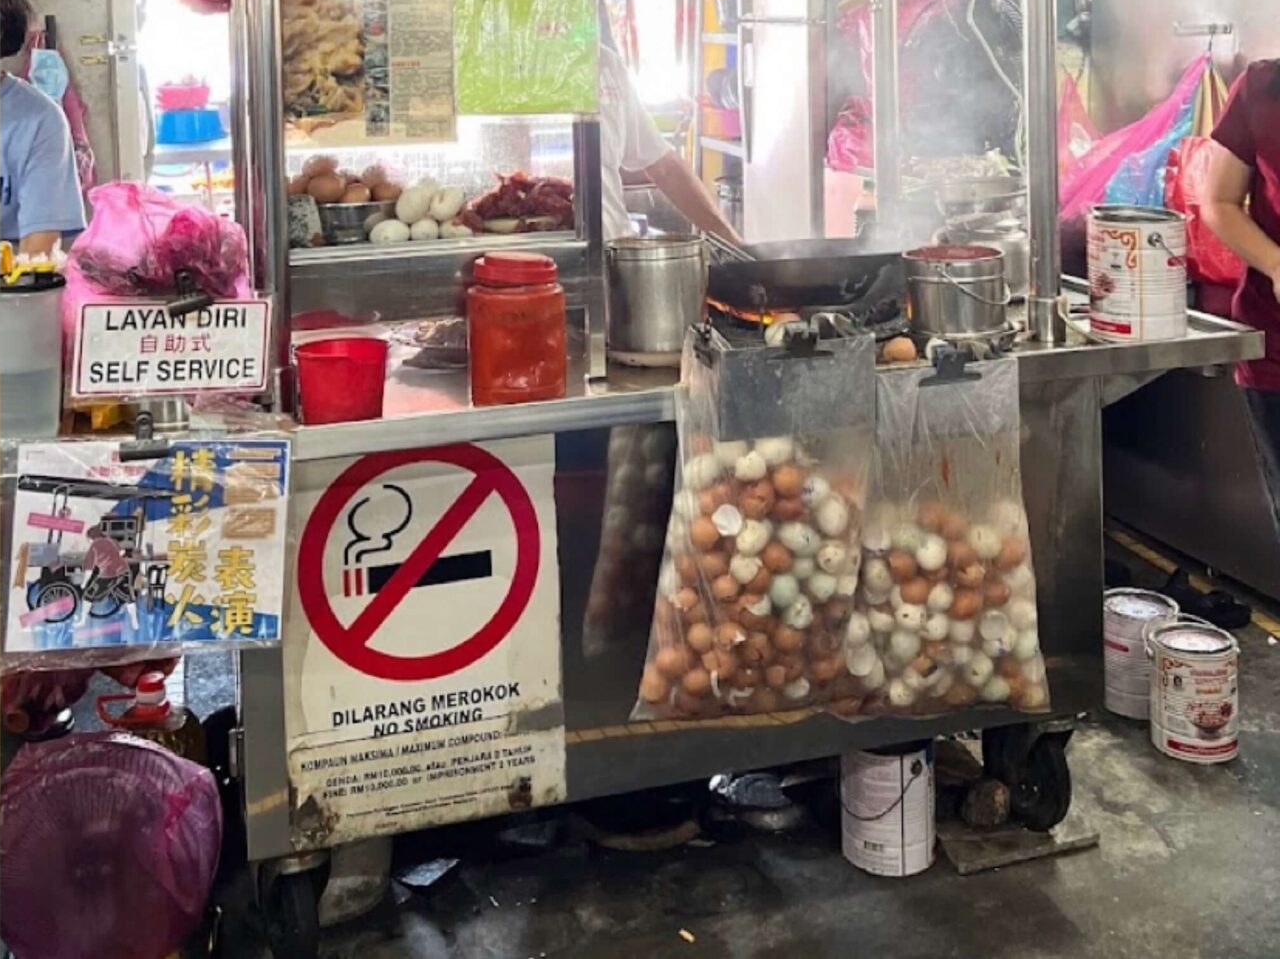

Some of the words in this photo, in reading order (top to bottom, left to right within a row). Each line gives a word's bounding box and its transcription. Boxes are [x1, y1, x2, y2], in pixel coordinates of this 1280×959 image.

[106, 308, 185, 331] LAYAN
[197, 307, 247, 329] DIRI
[140, 334, 211, 354] 自助式
[89, 361, 150, 384] SELF
[156, 358, 255, 381] SERVICE
[165, 448, 216, 629] 精彩炭火
[211, 545, 257, 636] 表演
[332, 699, 426, 728] DILARANG
[432, 682, 521, 710] MEROKOK
[373, 719, 398, 738] NO
[404, 708, 483, 734] SMOKING
